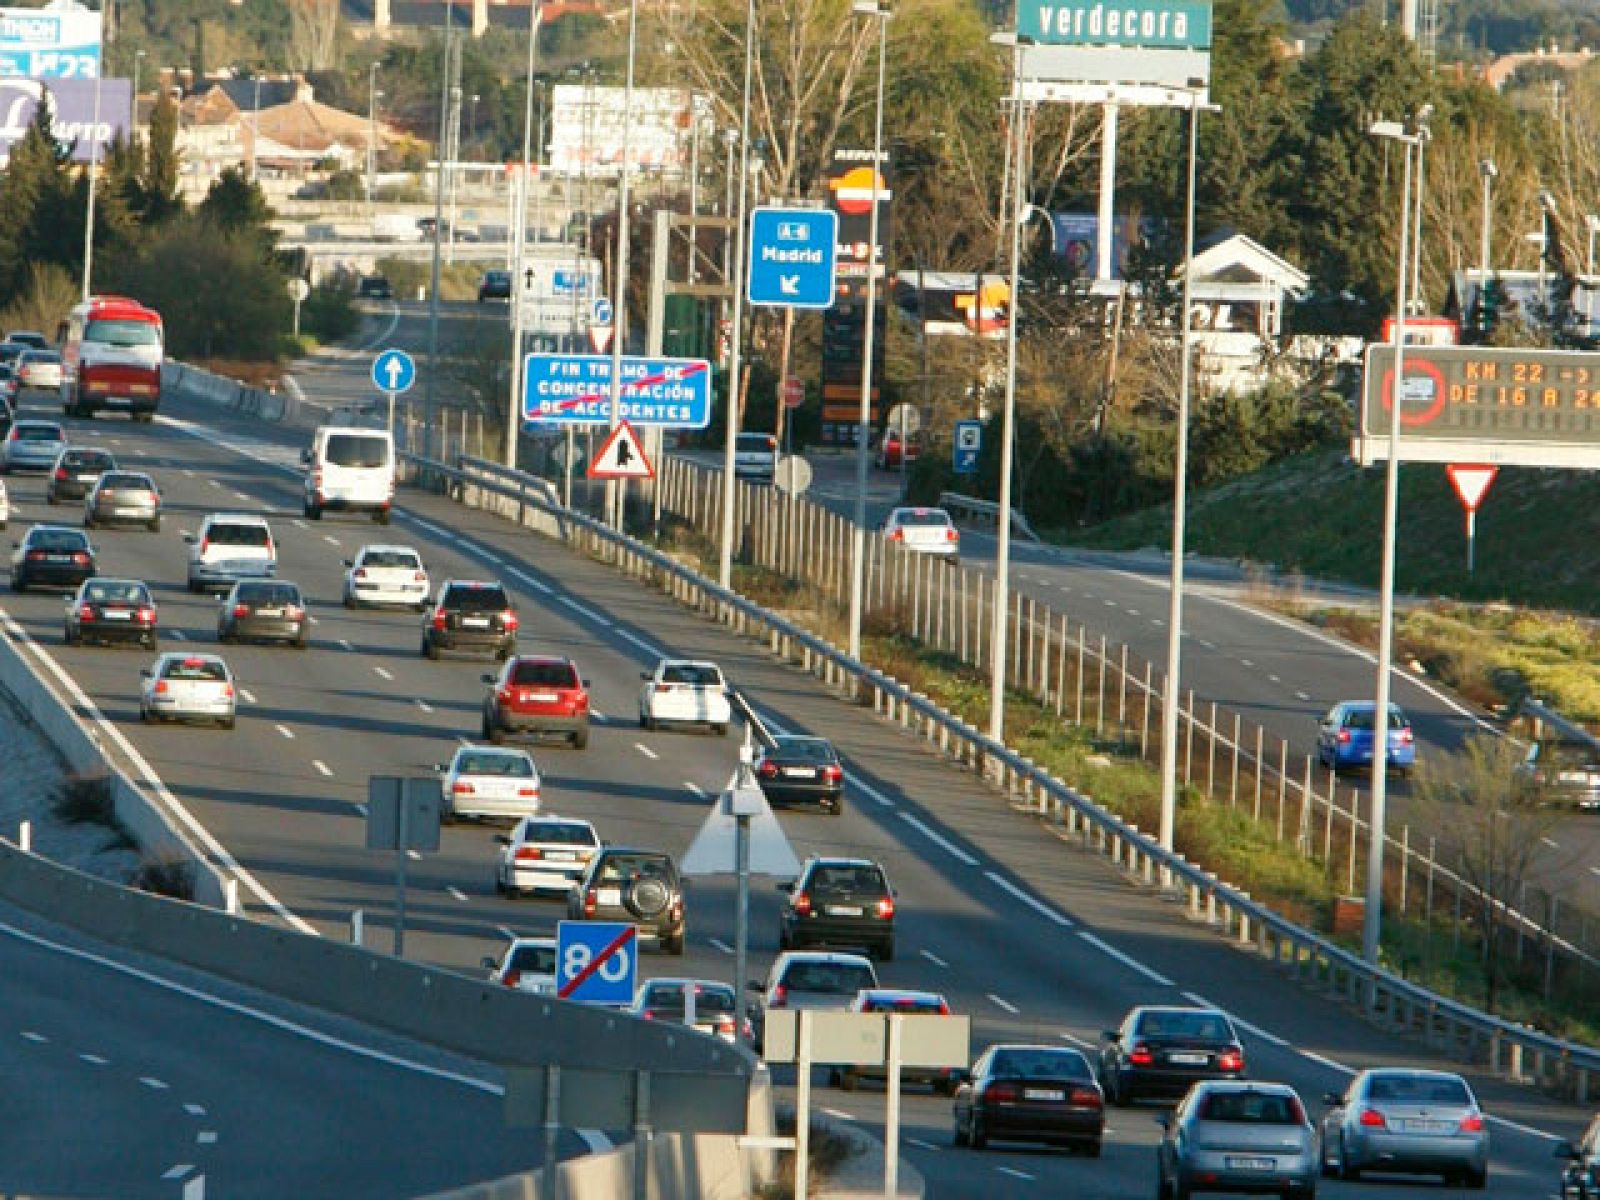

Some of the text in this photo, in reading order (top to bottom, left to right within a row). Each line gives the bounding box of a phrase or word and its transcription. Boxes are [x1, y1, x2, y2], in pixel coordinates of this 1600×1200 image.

[1039, 5, 1187, 38] verdecora
[762, 245, 822, 263] Madrid
[550, 362, 580, 376] FIN
[588, 363, 648, 378] TRMO
[1466, 361, 1496, 380] KM
[1514, 364, 1542, 382] 22
[537, 380, 695, 400] CONCENRACIÓN
[1450, 384, 1478, 403] DE
[1499, 386, 1526, 405] 16
[1543, 388, 1557, 408] A
[574, 403, 691, 420] ACCDENTES
[564, 943, 629, 981] 80
